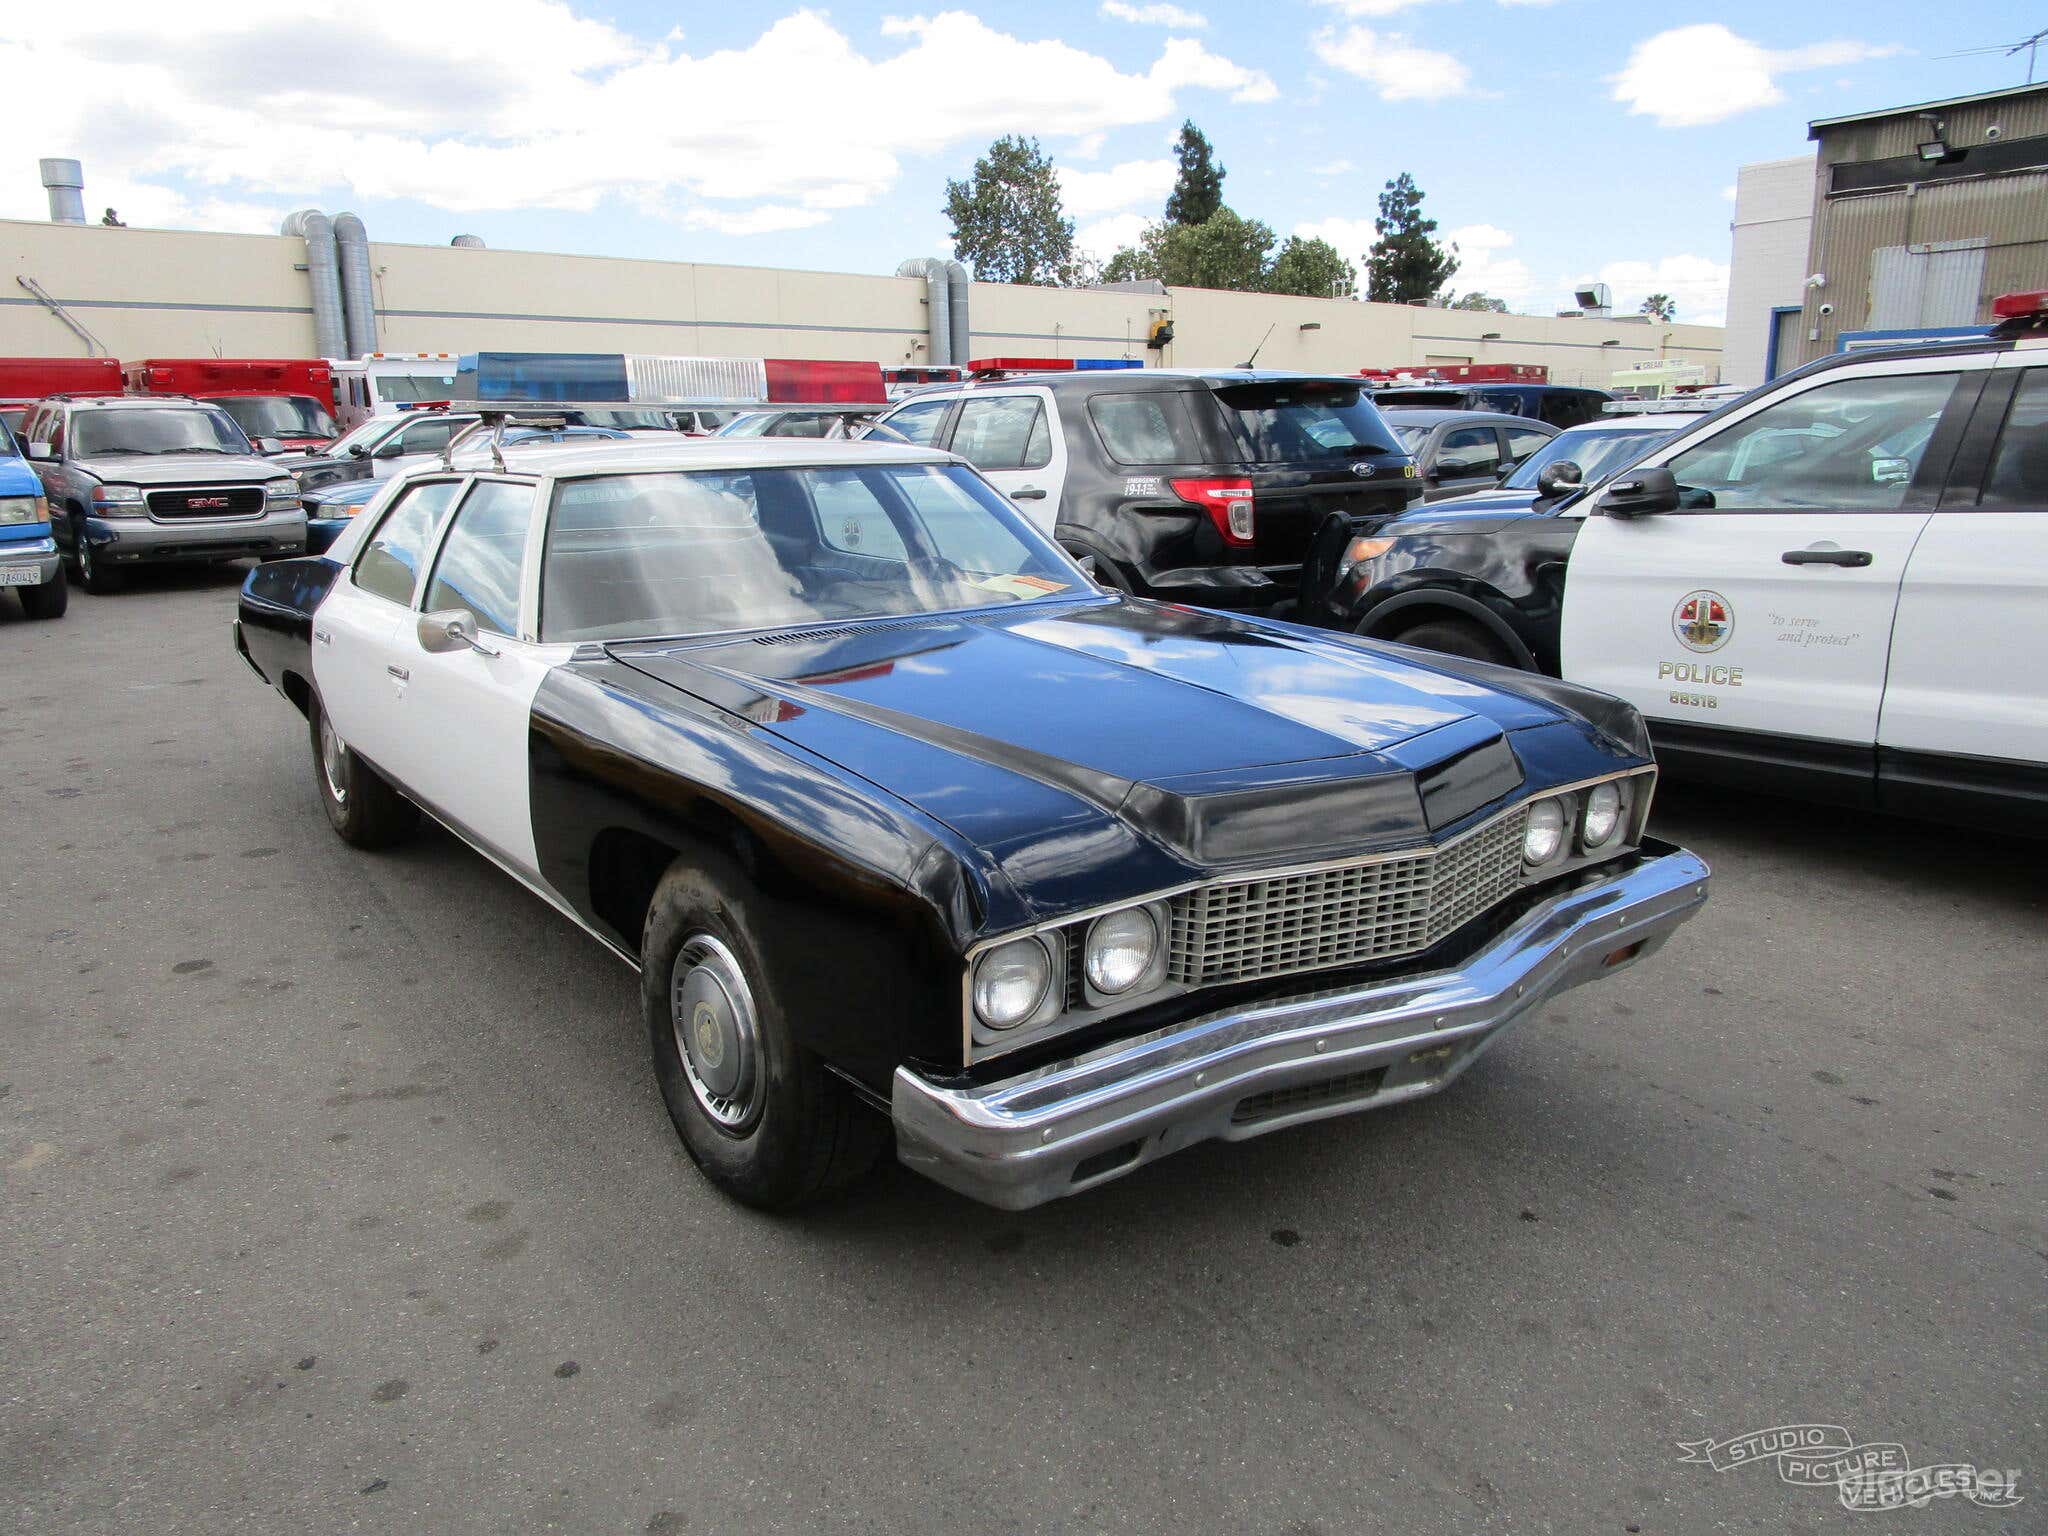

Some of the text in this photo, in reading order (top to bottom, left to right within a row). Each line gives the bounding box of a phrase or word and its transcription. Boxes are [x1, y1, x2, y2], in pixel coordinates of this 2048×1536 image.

[187, 497, 230, 508] GMC
[1778, 630, 1805, 643] and
[1658, 661, 1743, 687] POLICE
